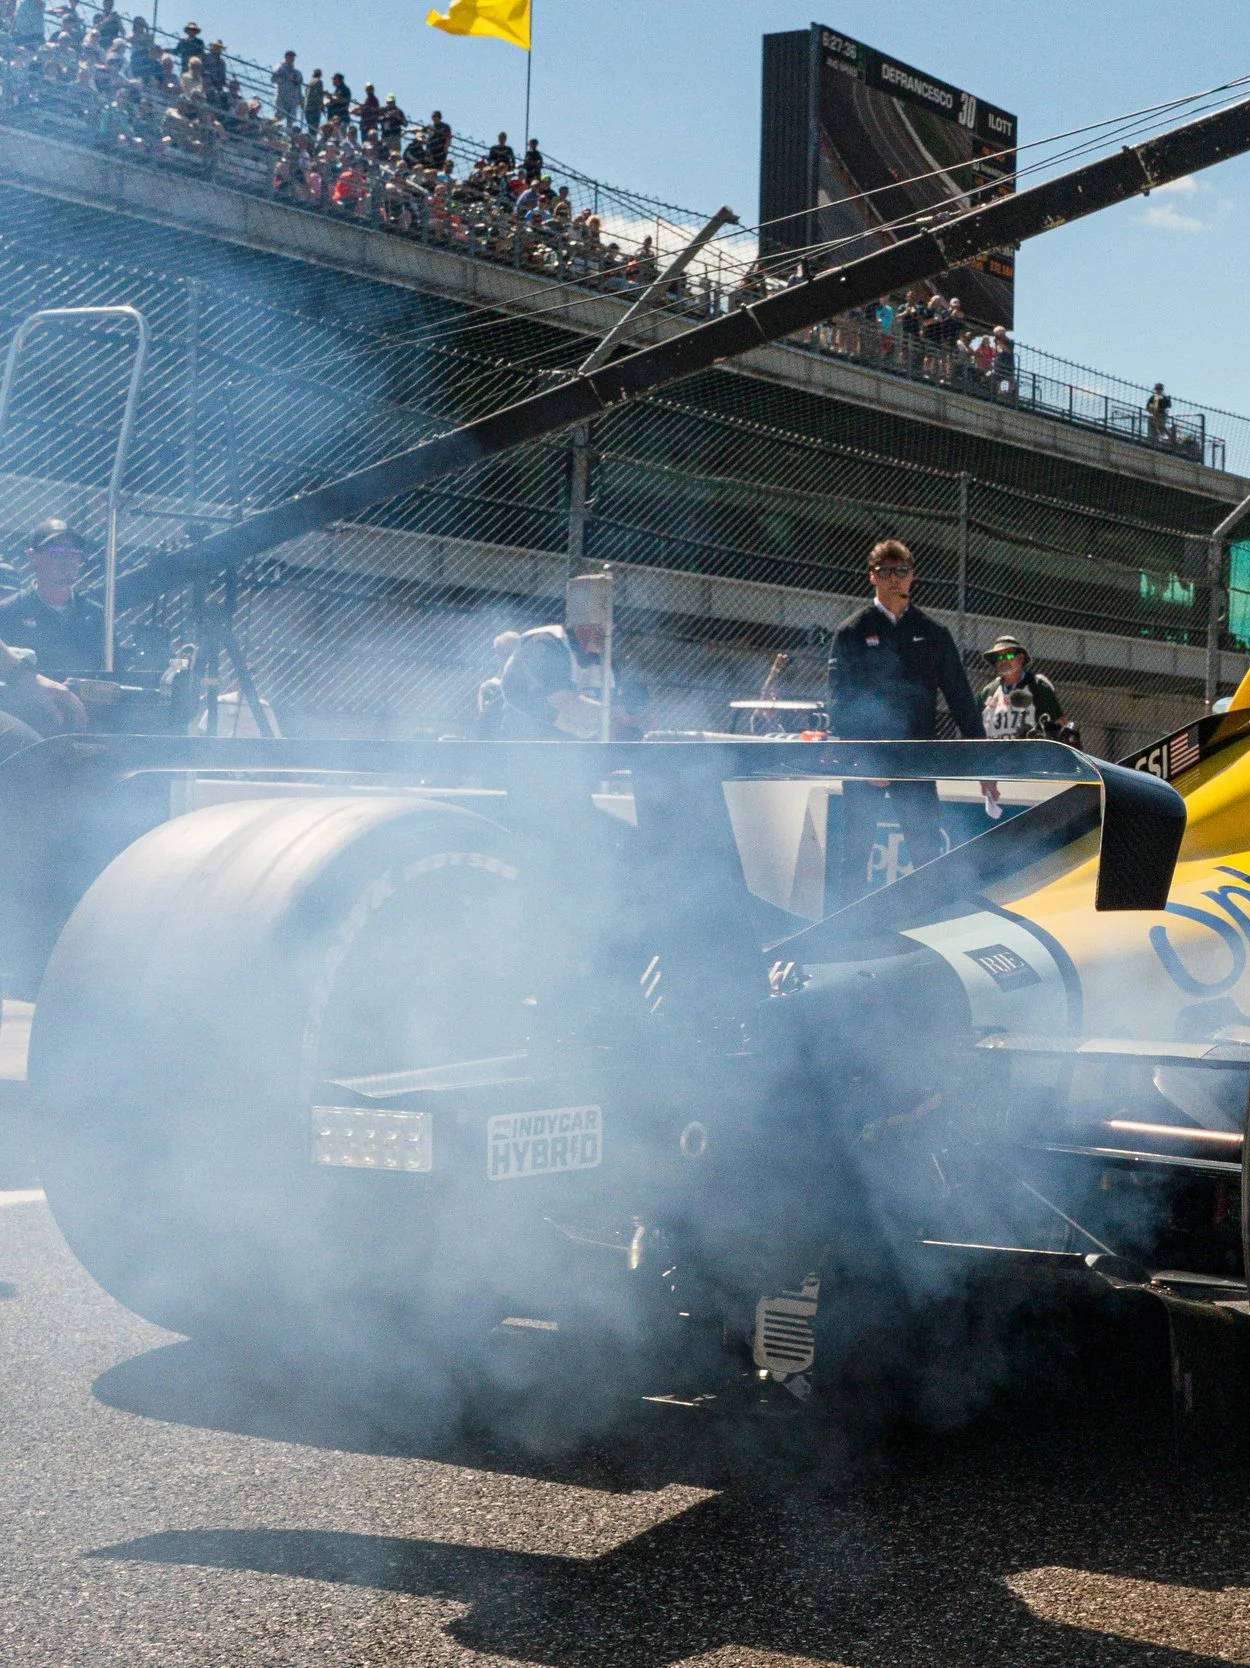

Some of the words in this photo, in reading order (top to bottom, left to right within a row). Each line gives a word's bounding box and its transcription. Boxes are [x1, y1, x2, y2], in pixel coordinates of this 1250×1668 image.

[881, 63, 953, 109] DEFRANCESCO
[958, 92, 976, 129] 30
[988, 113, 1012, 137] ILOTT
[979, 951, 1025, 974] RJE
[512, 1110, 598, 1139] INDYCAR
[491, 1133, 597, 1176] HYBRID
